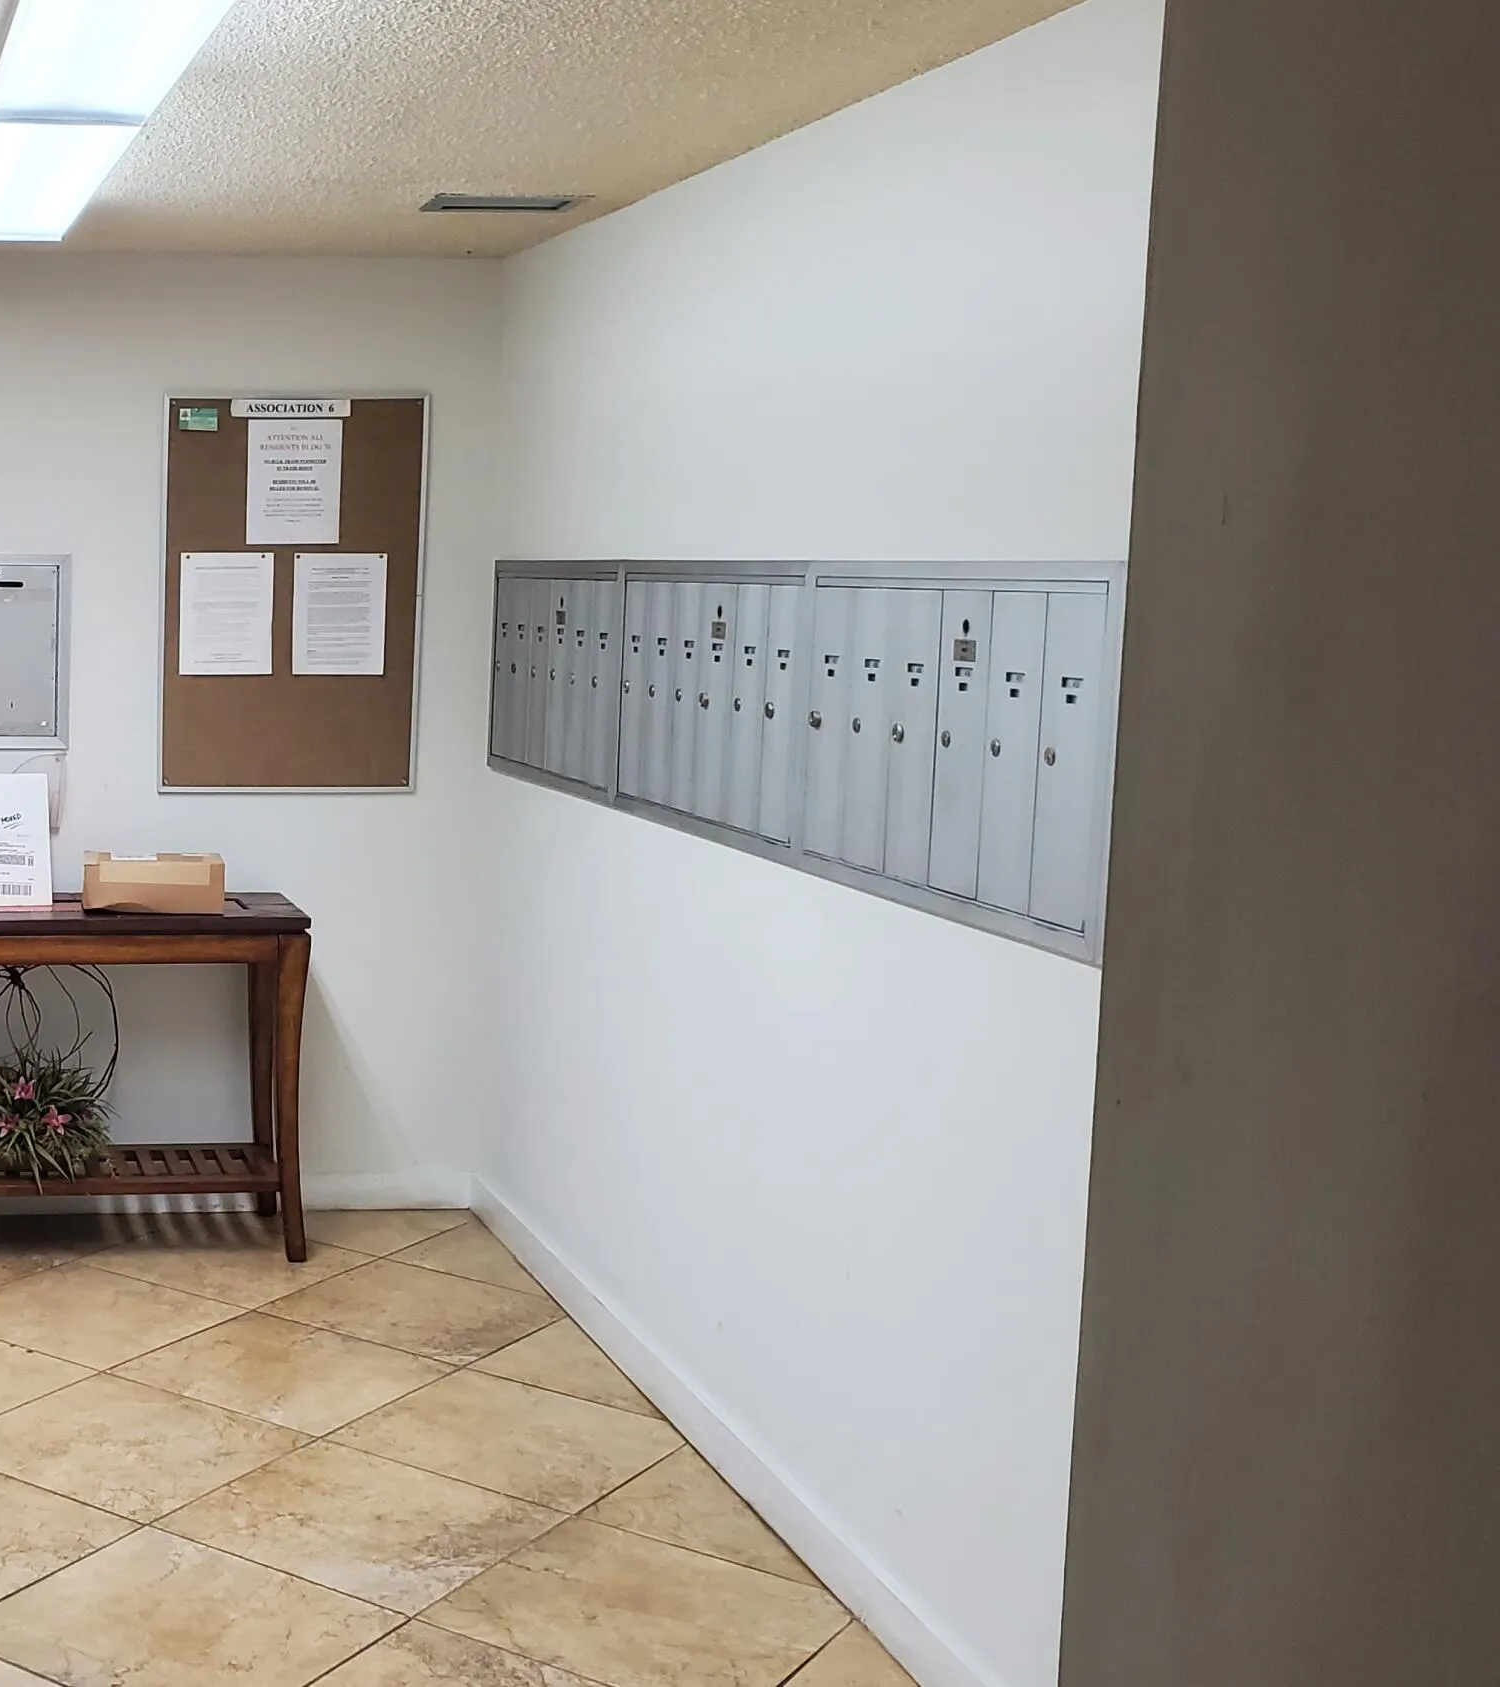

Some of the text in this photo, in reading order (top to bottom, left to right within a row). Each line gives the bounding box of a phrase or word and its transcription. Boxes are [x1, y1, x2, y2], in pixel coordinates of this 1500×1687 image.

[246, 403, 335, 413] ASSOCIATION 6
[260, 443, 299, 451] RESIDENTS
[1, 813, 22, 824] MOVED
